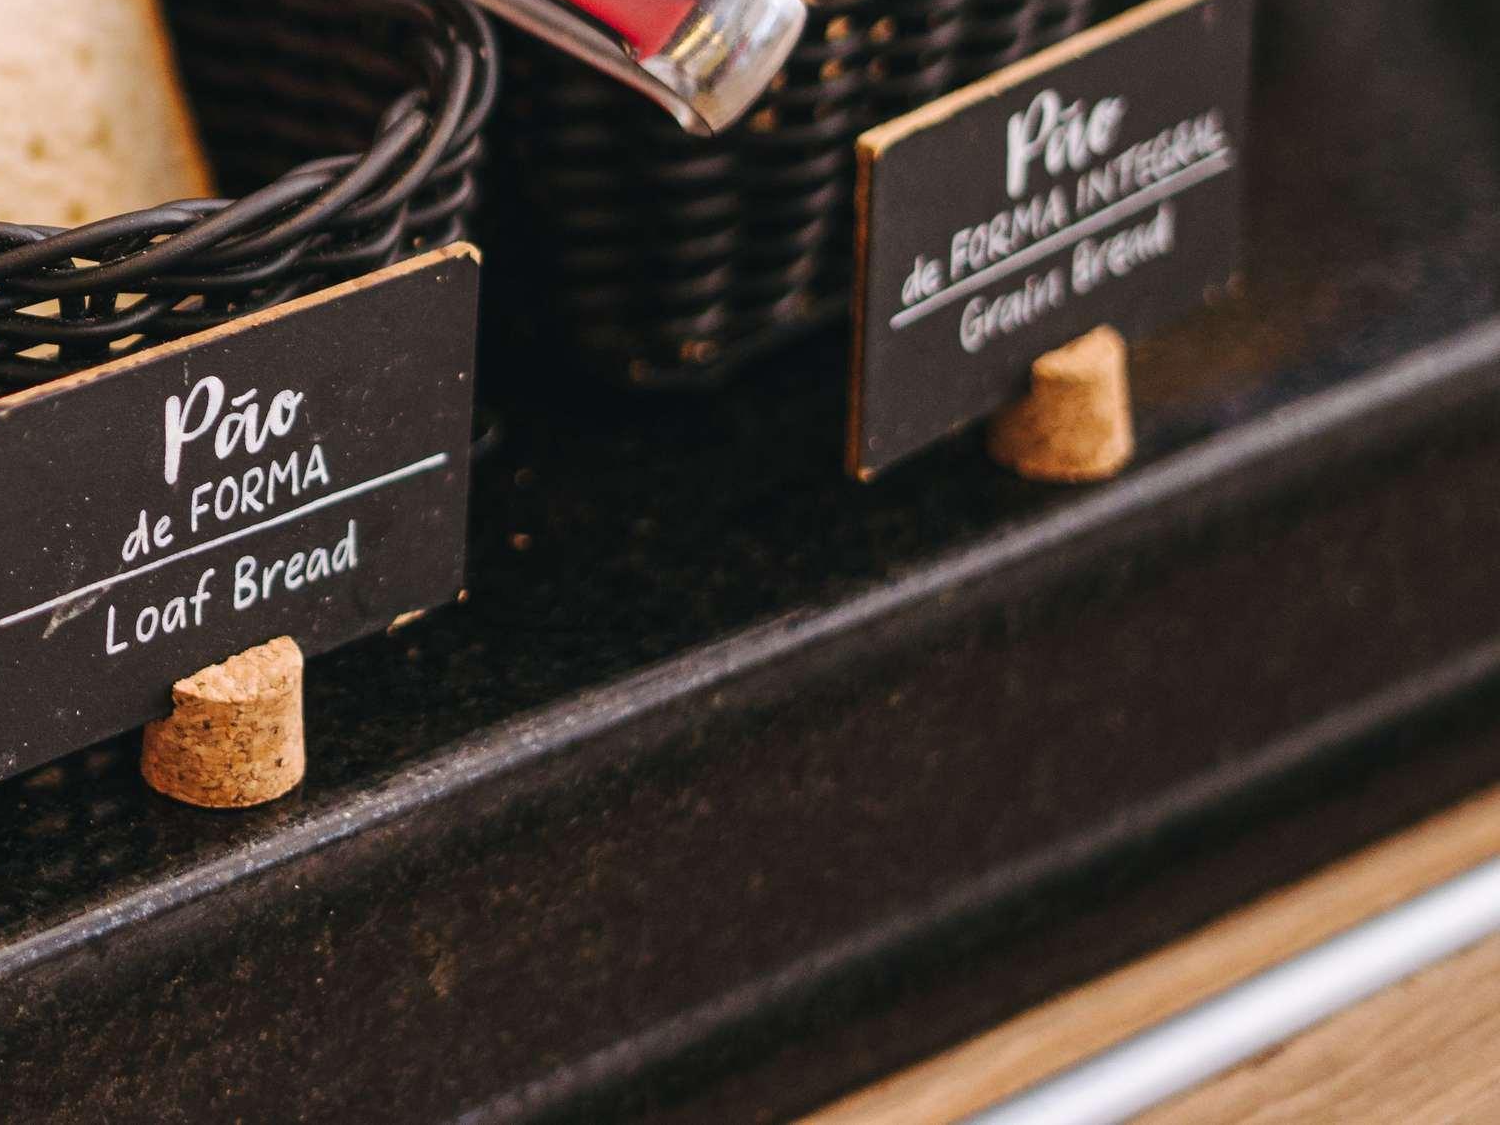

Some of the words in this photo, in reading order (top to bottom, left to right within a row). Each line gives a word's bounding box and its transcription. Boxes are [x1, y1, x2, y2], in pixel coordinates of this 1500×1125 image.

[1007, 88, 1126, 199] Pão
[901, 253, 946, 307] de
[950, 185, 1070, 280] FORMA
[959, 267, 1066, 354] Grain
[1071, 201, 1177, 295] Bread
[164, 375, 304, 485] Pão
[121, 509, 173, 562] de
[190, 443, 330, 533] FORMA
[105, 568, 215, 655] Loaf
[233, 519, 358, 611] Bread
